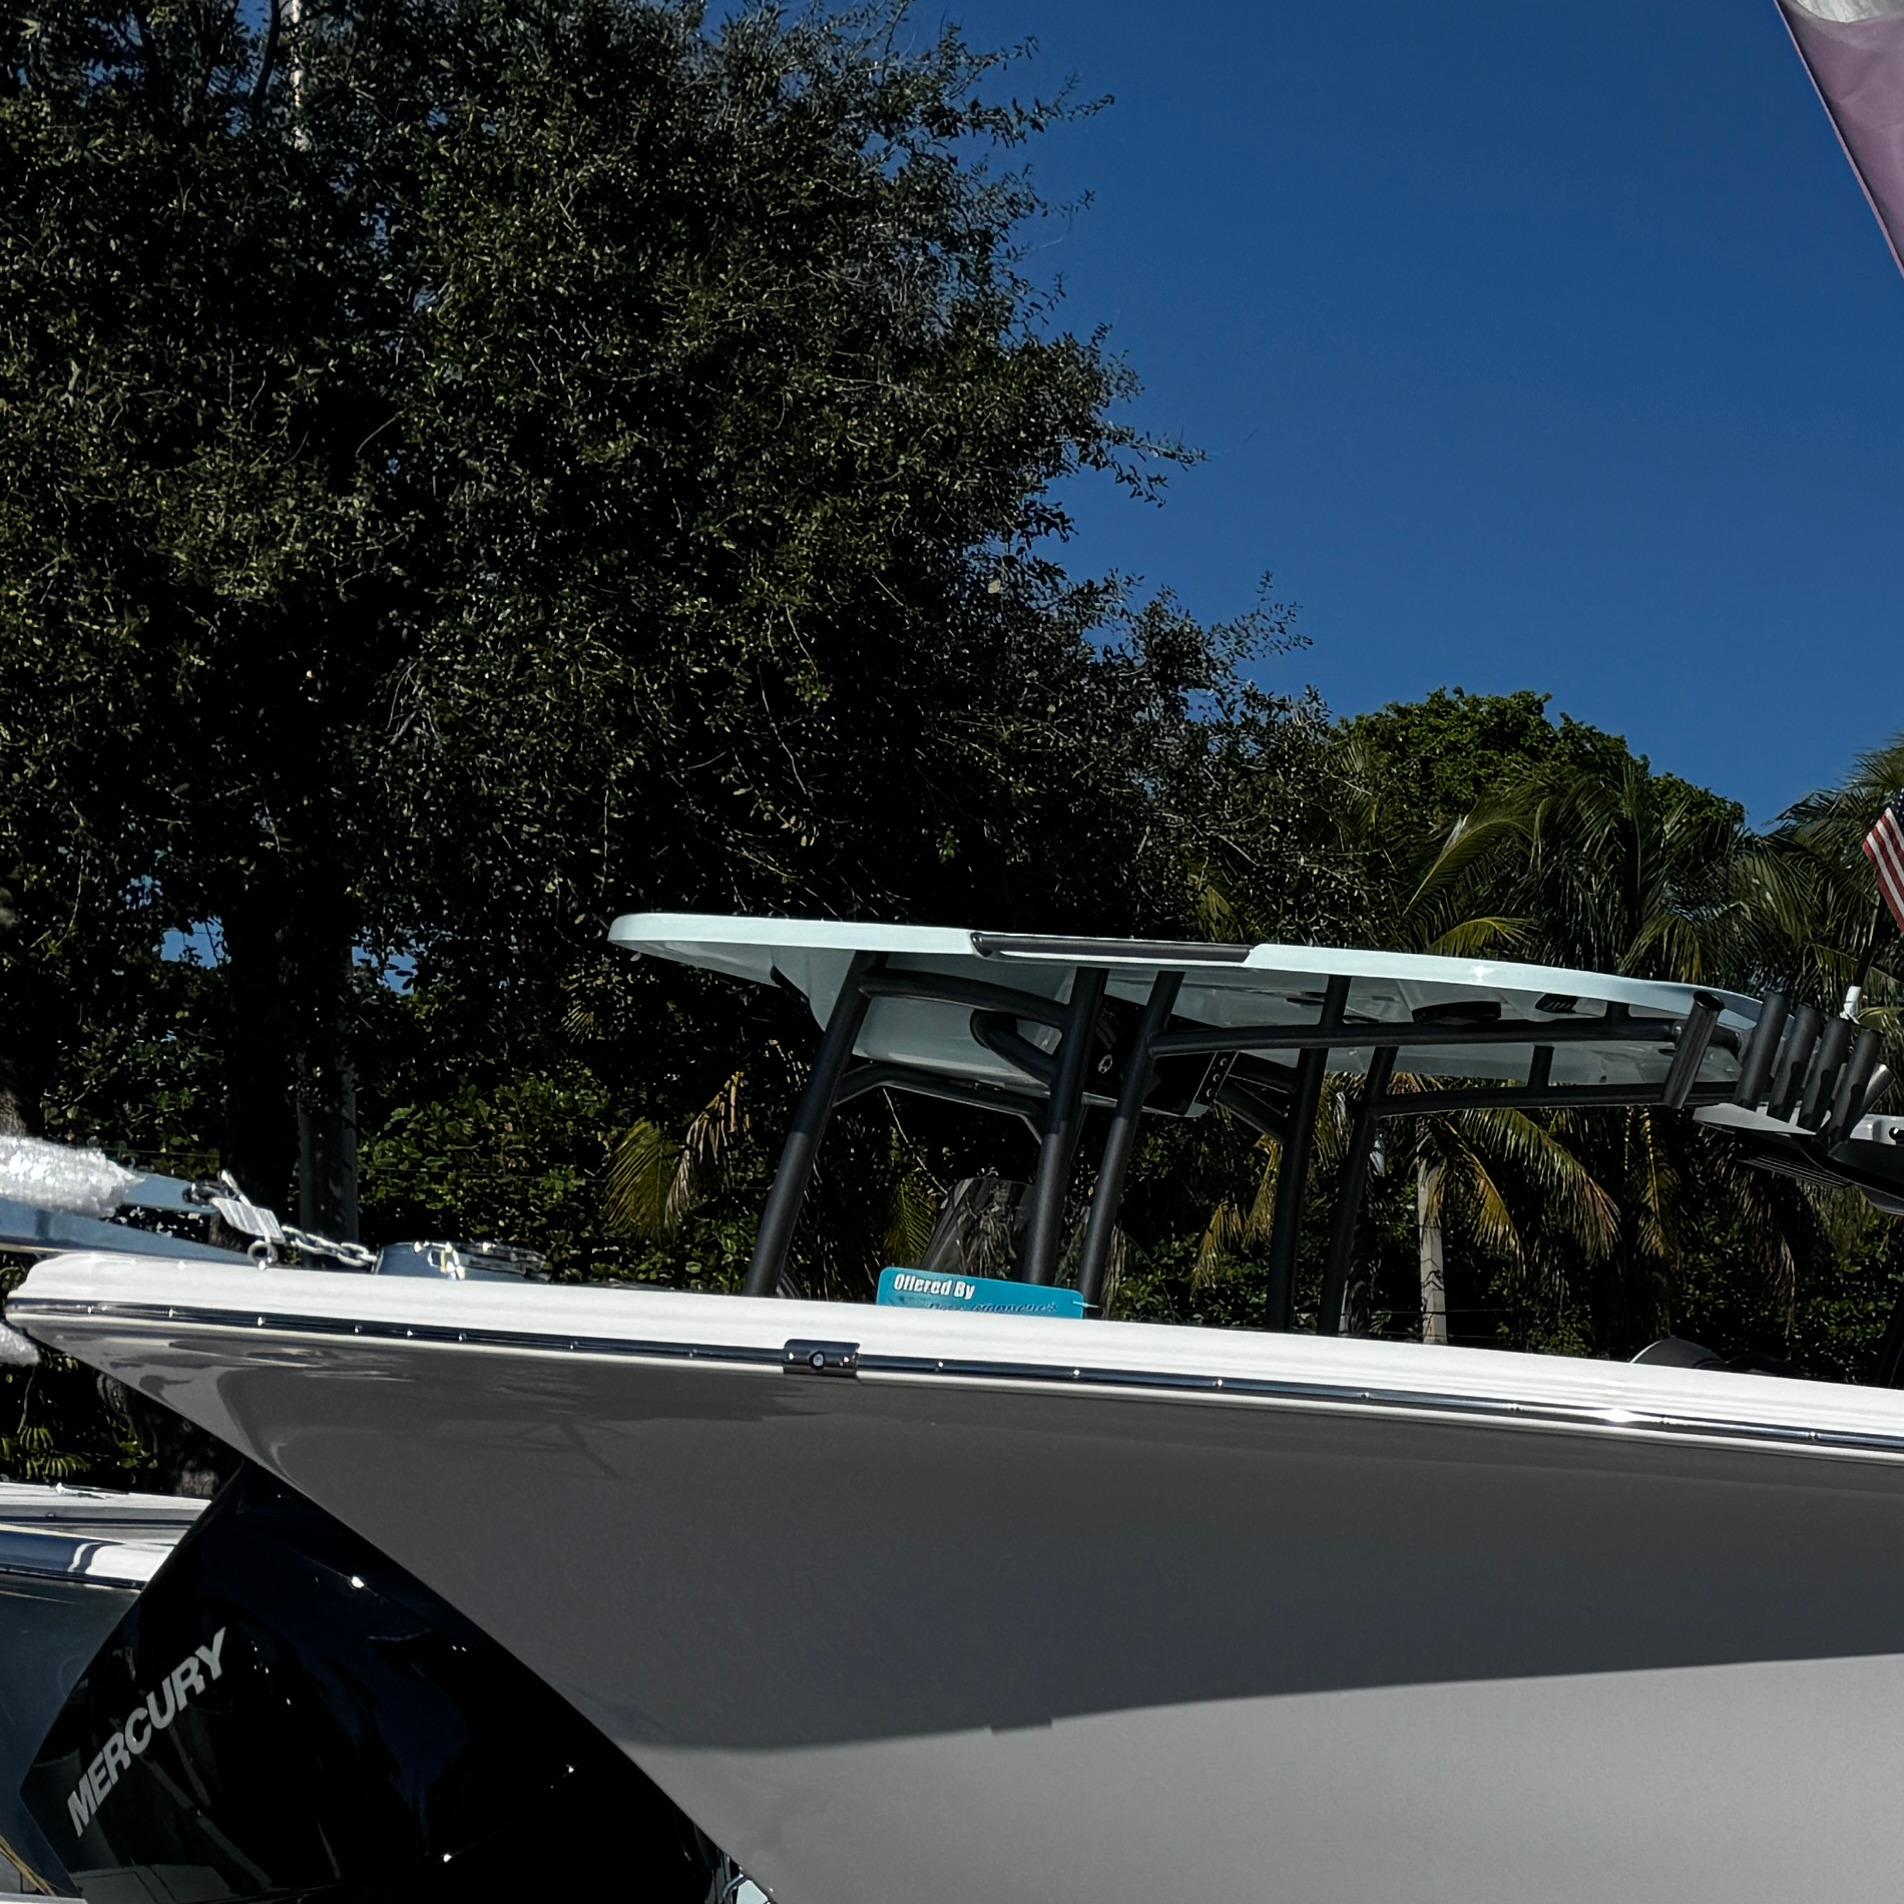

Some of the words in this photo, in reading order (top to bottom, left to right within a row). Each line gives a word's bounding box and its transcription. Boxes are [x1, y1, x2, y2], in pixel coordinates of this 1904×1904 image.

[893, 1273, 952, 1296] Offered
[954, 1280, 976, 1300] By
[67, 1627, 226, 1838] MERCURY
